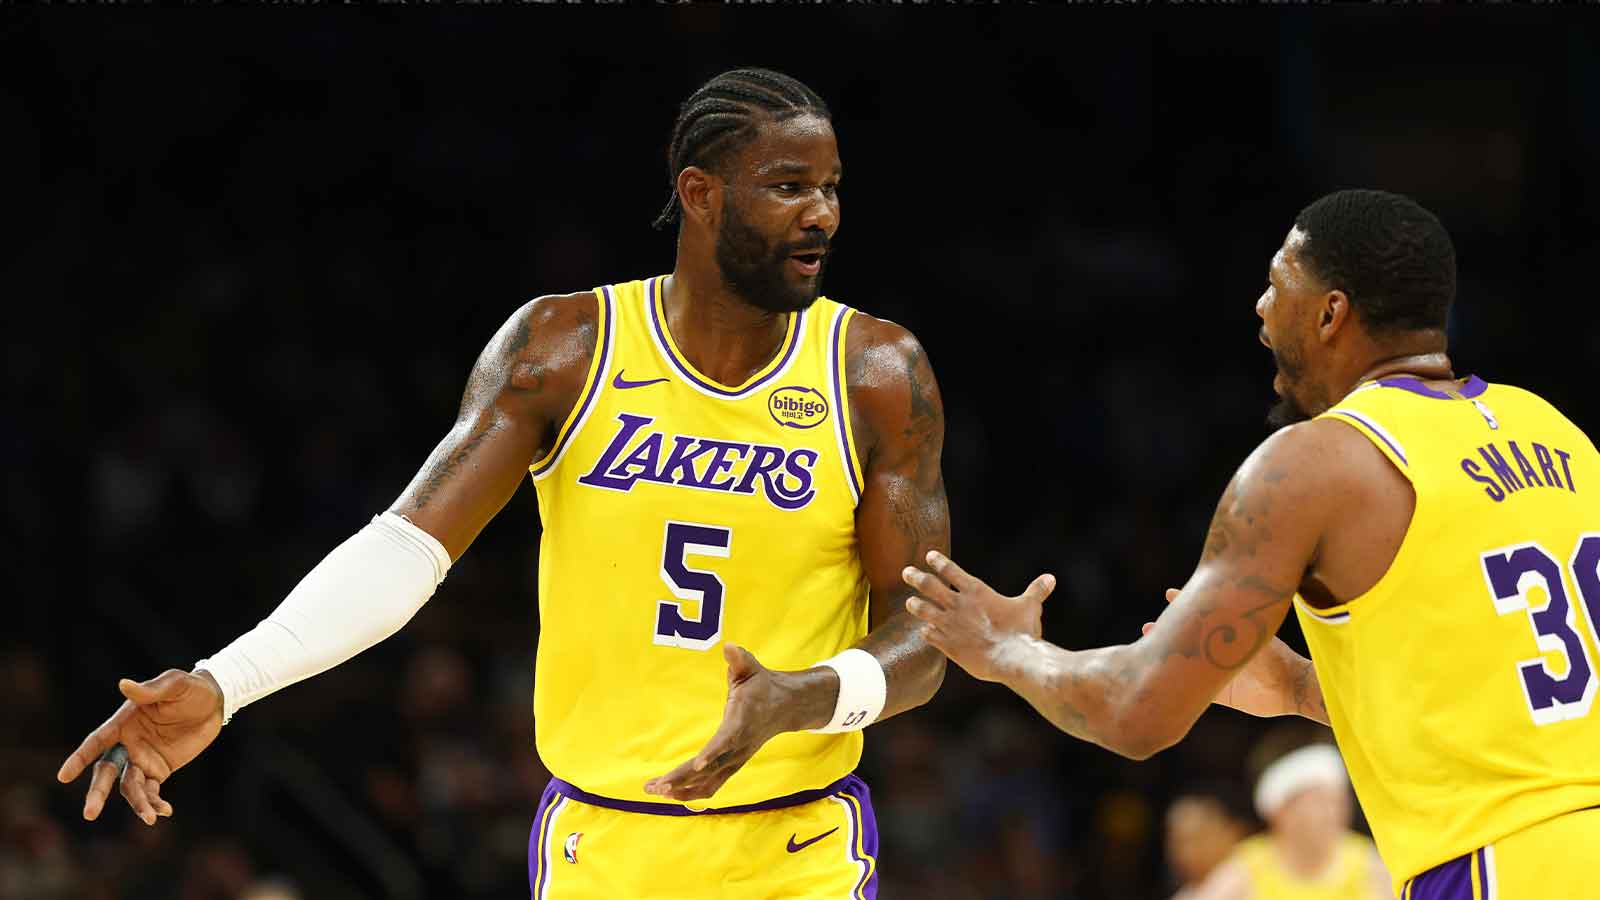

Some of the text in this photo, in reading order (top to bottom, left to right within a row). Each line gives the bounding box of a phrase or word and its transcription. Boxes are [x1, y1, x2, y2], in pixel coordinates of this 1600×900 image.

[774, 396, 825, 417] bibigo
[578, 413, 819, 510] LAKERS
[1460, 440, 1576, 503] SMART
[654, 520, 732, 650] 5
